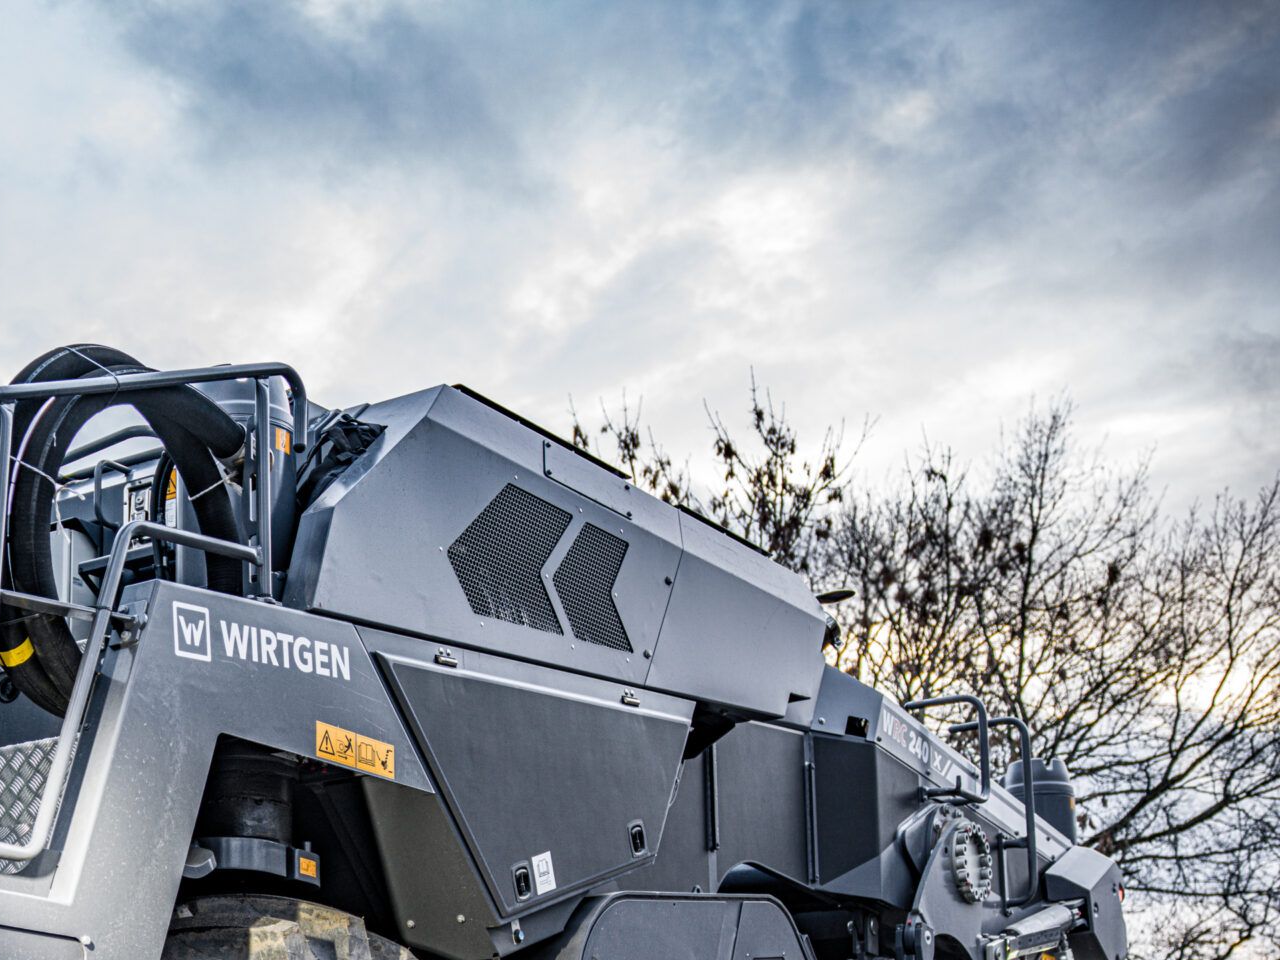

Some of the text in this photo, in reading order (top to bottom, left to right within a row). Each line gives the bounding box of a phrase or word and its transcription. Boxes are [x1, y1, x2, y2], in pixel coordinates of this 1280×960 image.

[219, 619, 351, 682] WIRTGEN
[882, 708, 908, 749] WRC
[908, 731, 930, 765] 240
